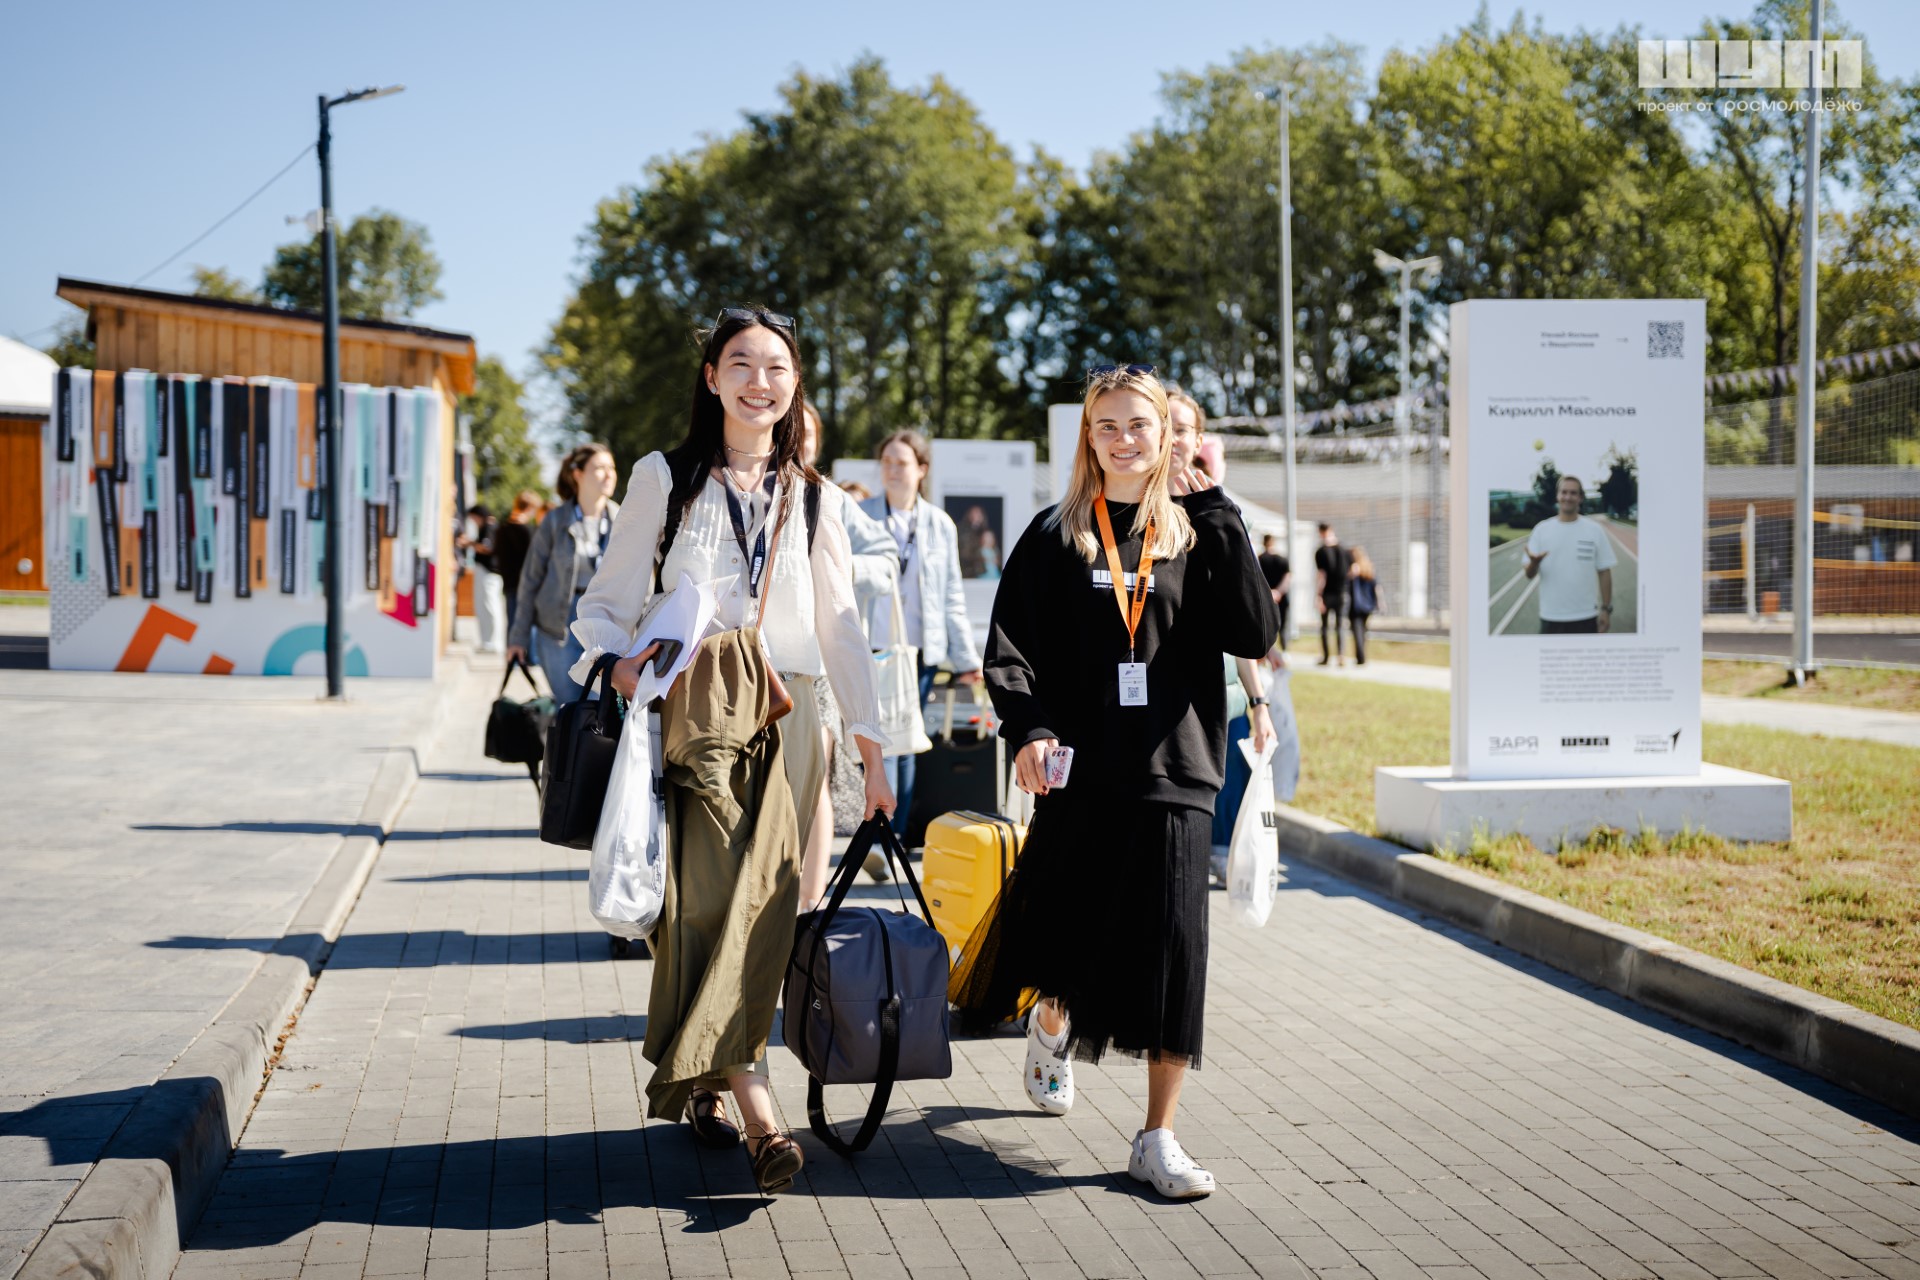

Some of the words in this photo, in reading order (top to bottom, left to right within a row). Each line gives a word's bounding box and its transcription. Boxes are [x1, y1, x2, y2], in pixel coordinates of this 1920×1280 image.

[1488, 404, 1553, 418] Кирилл
[1558, 403, 1637, 417] Масолов
[1489, 736, 1539, 749] ЗАРЯ
